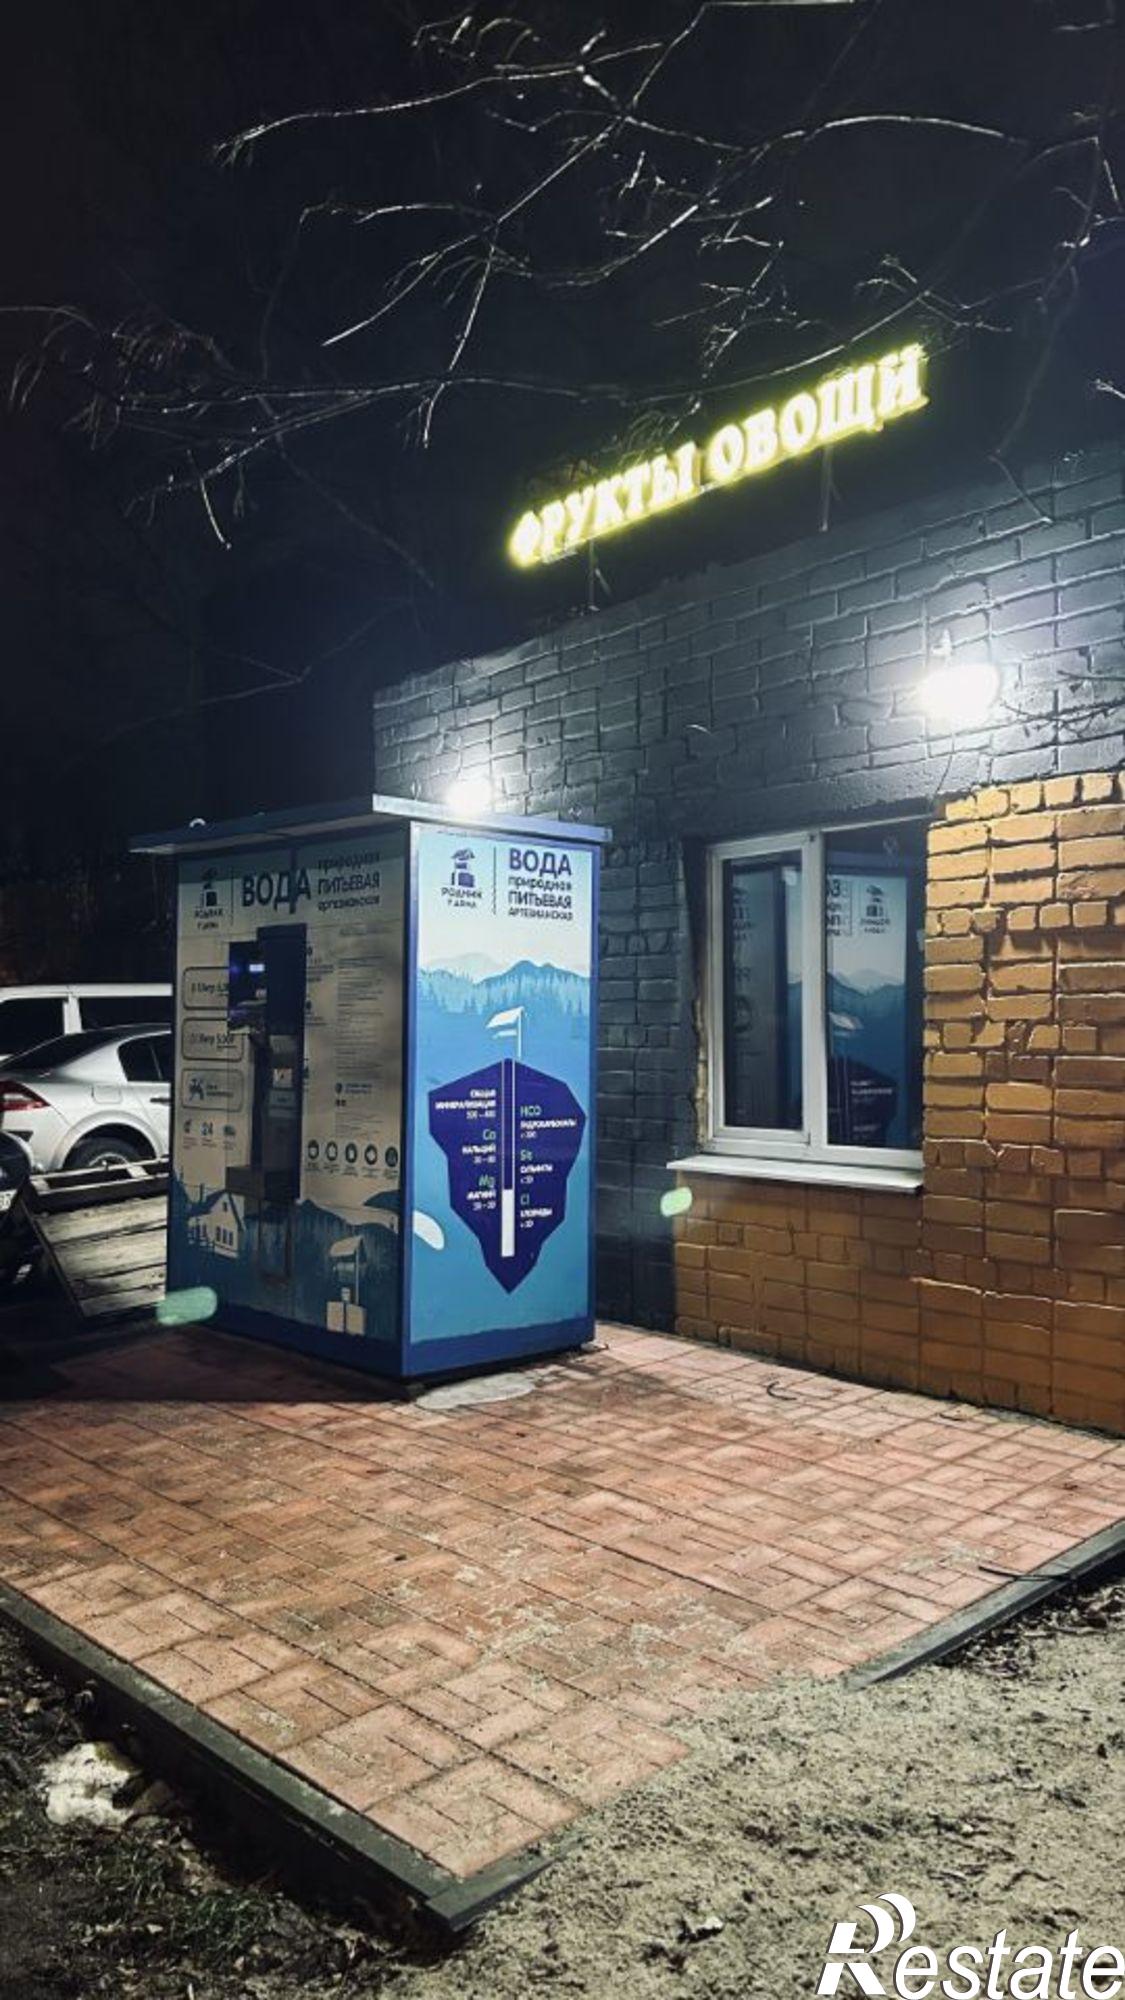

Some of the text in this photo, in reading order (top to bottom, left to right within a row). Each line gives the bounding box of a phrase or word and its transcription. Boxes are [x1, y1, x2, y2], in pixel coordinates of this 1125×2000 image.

[510, 343, 929, 565] ФРУКТЫ ОВОЩИ
[508, 847, 572, 878] ВОДА
[242, 868, 311, 914] ВОДА
[318, 872, 380, 895] ПИТЬЕВАЯ
[508, 876, 572, 892] природная
[508, 891, 572, 909] ПИТЬЕВАЯ
